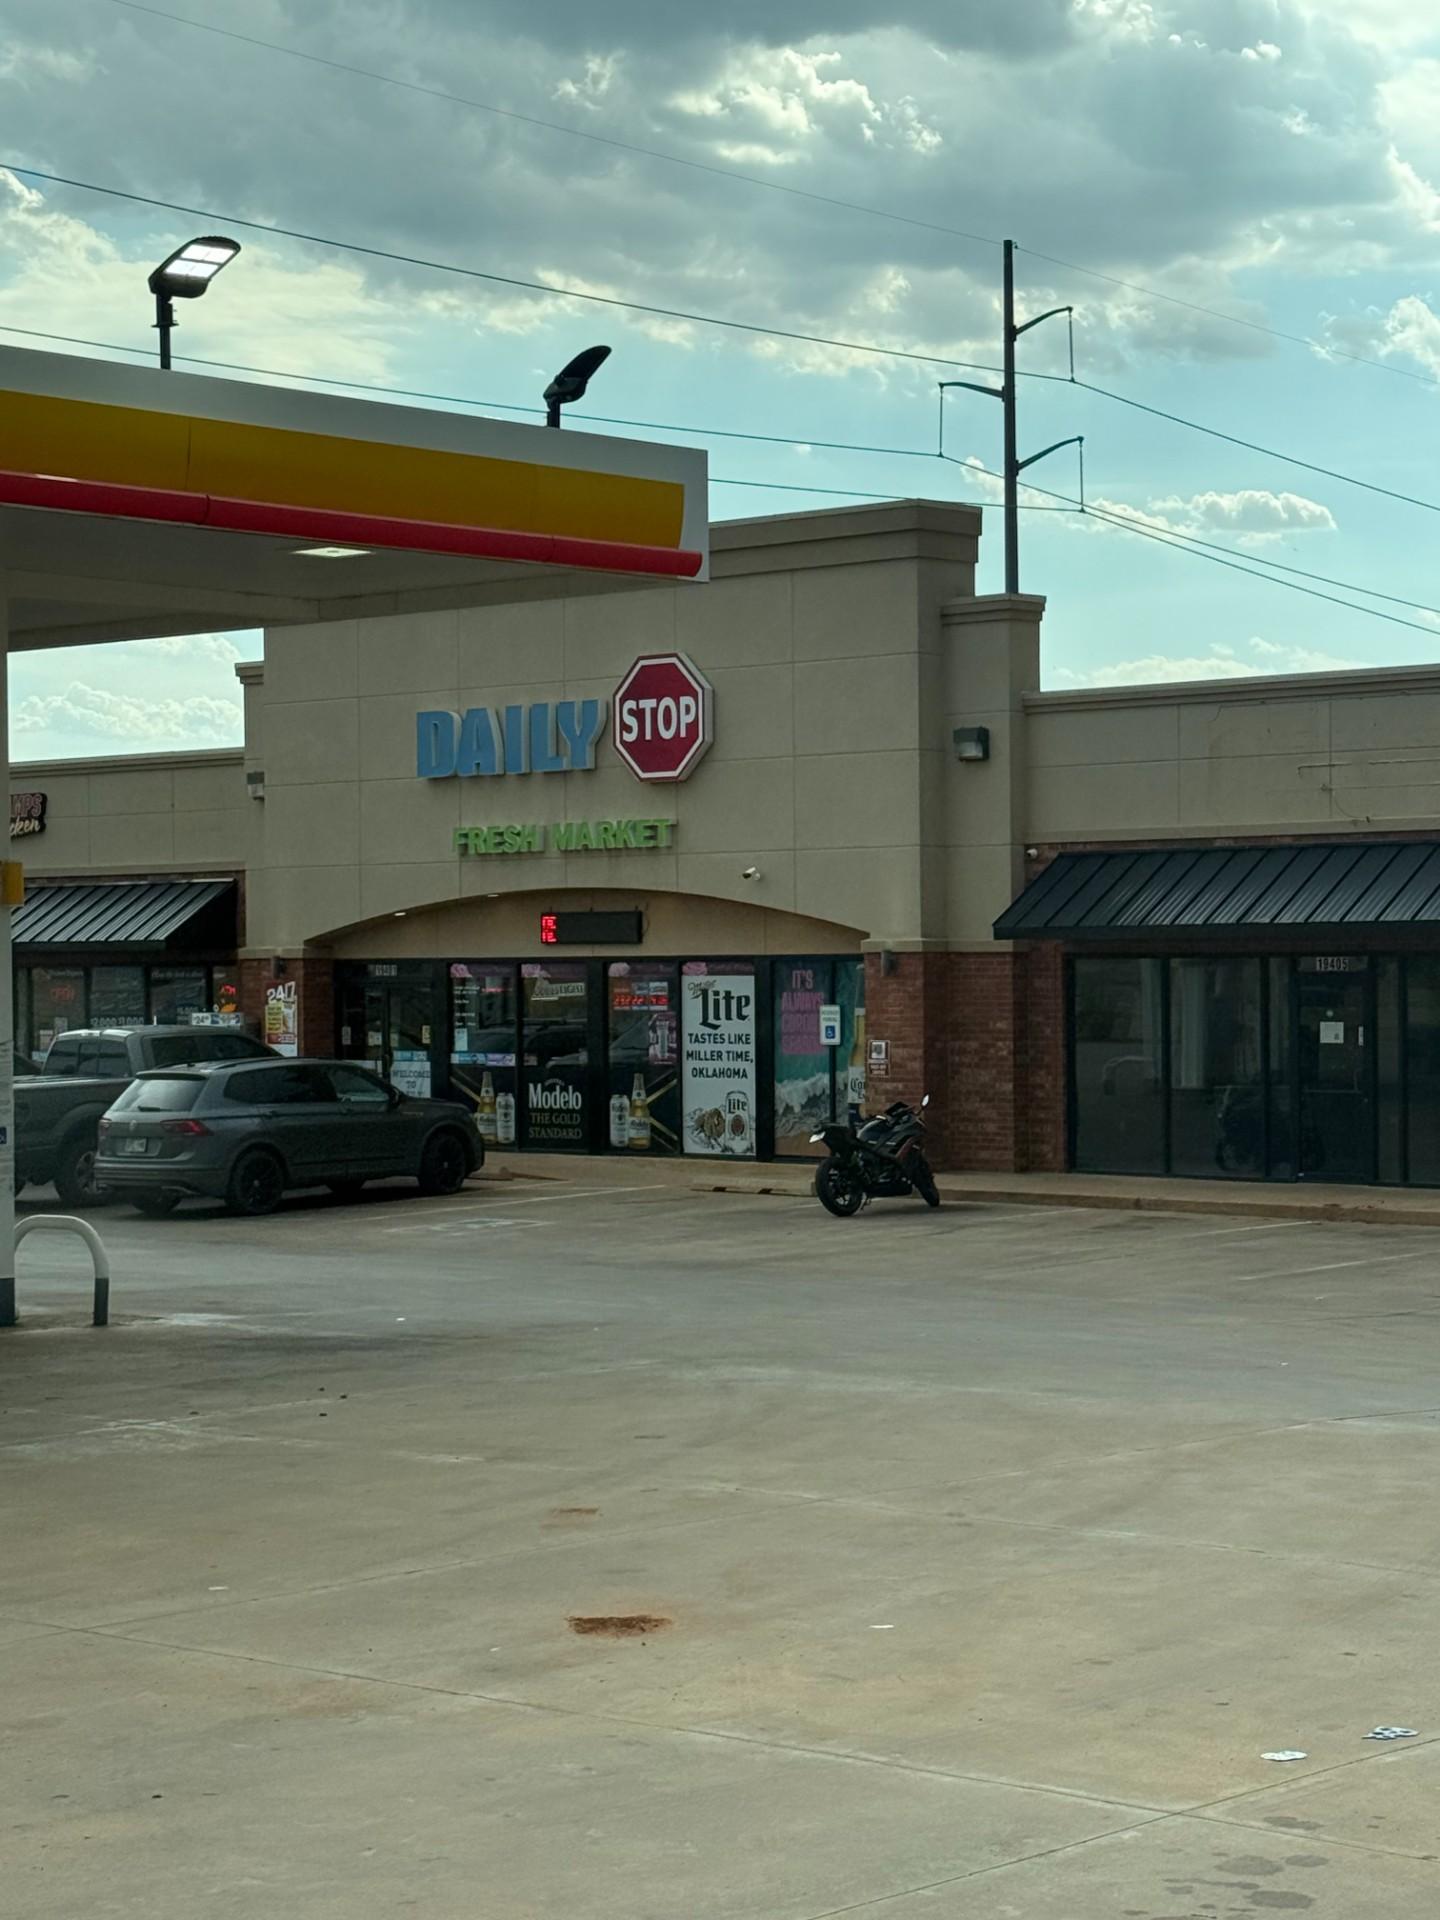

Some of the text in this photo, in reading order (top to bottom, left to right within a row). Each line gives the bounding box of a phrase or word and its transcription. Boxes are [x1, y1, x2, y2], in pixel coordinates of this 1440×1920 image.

[416, 695, 697, 778] DAILY STOP
[453, 818, 675, 855] FRESH MARKET
[1315, 956, 1349, 971] 19405
[791, 969, 814, 989] IT'S
[699, 988, 751, 1030] Lite
[688, 1032, 751, 1045] TASTES LIKE
[686, 1049, 723, 1062] MILLER
[725, 1050, 754, 1064] TIME,
[691, 1067, 749, 1080] OKLAHOMA
[527, 1082, 583, 1110] Modelo
[727, 1098, 748, 1114] Lite
[530, 1111, 581, 1125] THE GOLD
[528, 1126, 583, 1140] STANDARD
